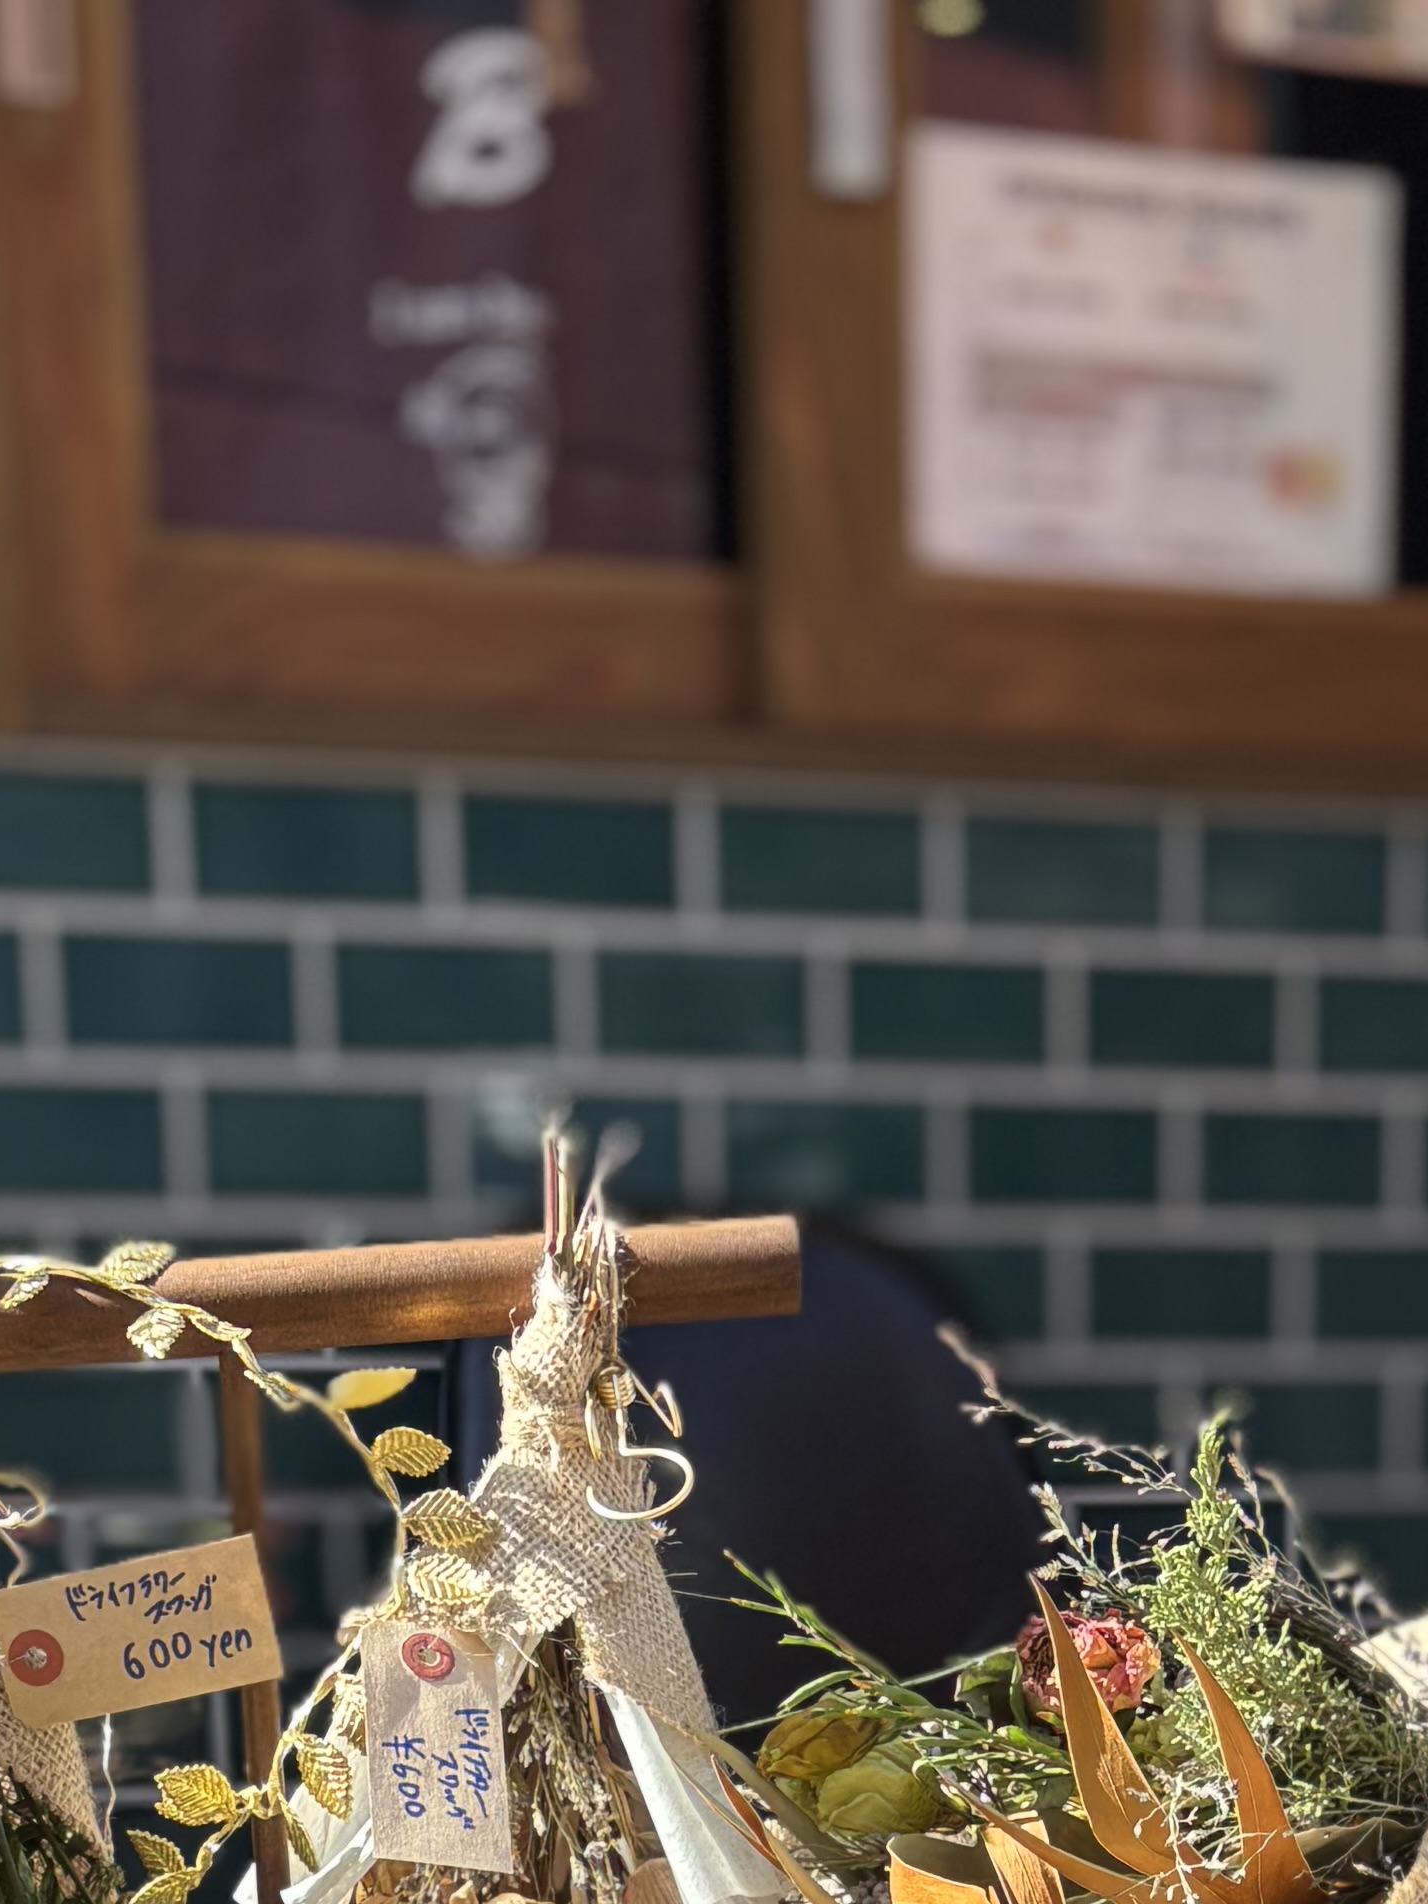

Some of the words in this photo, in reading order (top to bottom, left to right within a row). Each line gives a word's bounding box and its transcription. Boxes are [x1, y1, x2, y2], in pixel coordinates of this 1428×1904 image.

[65, 1570, 186, 1622] ドライフラワー
[123, 1631, 193, 1680] 600
[199, 1628, 253, 1668] yen
[381, 1734, 427, 1819] ¥600
